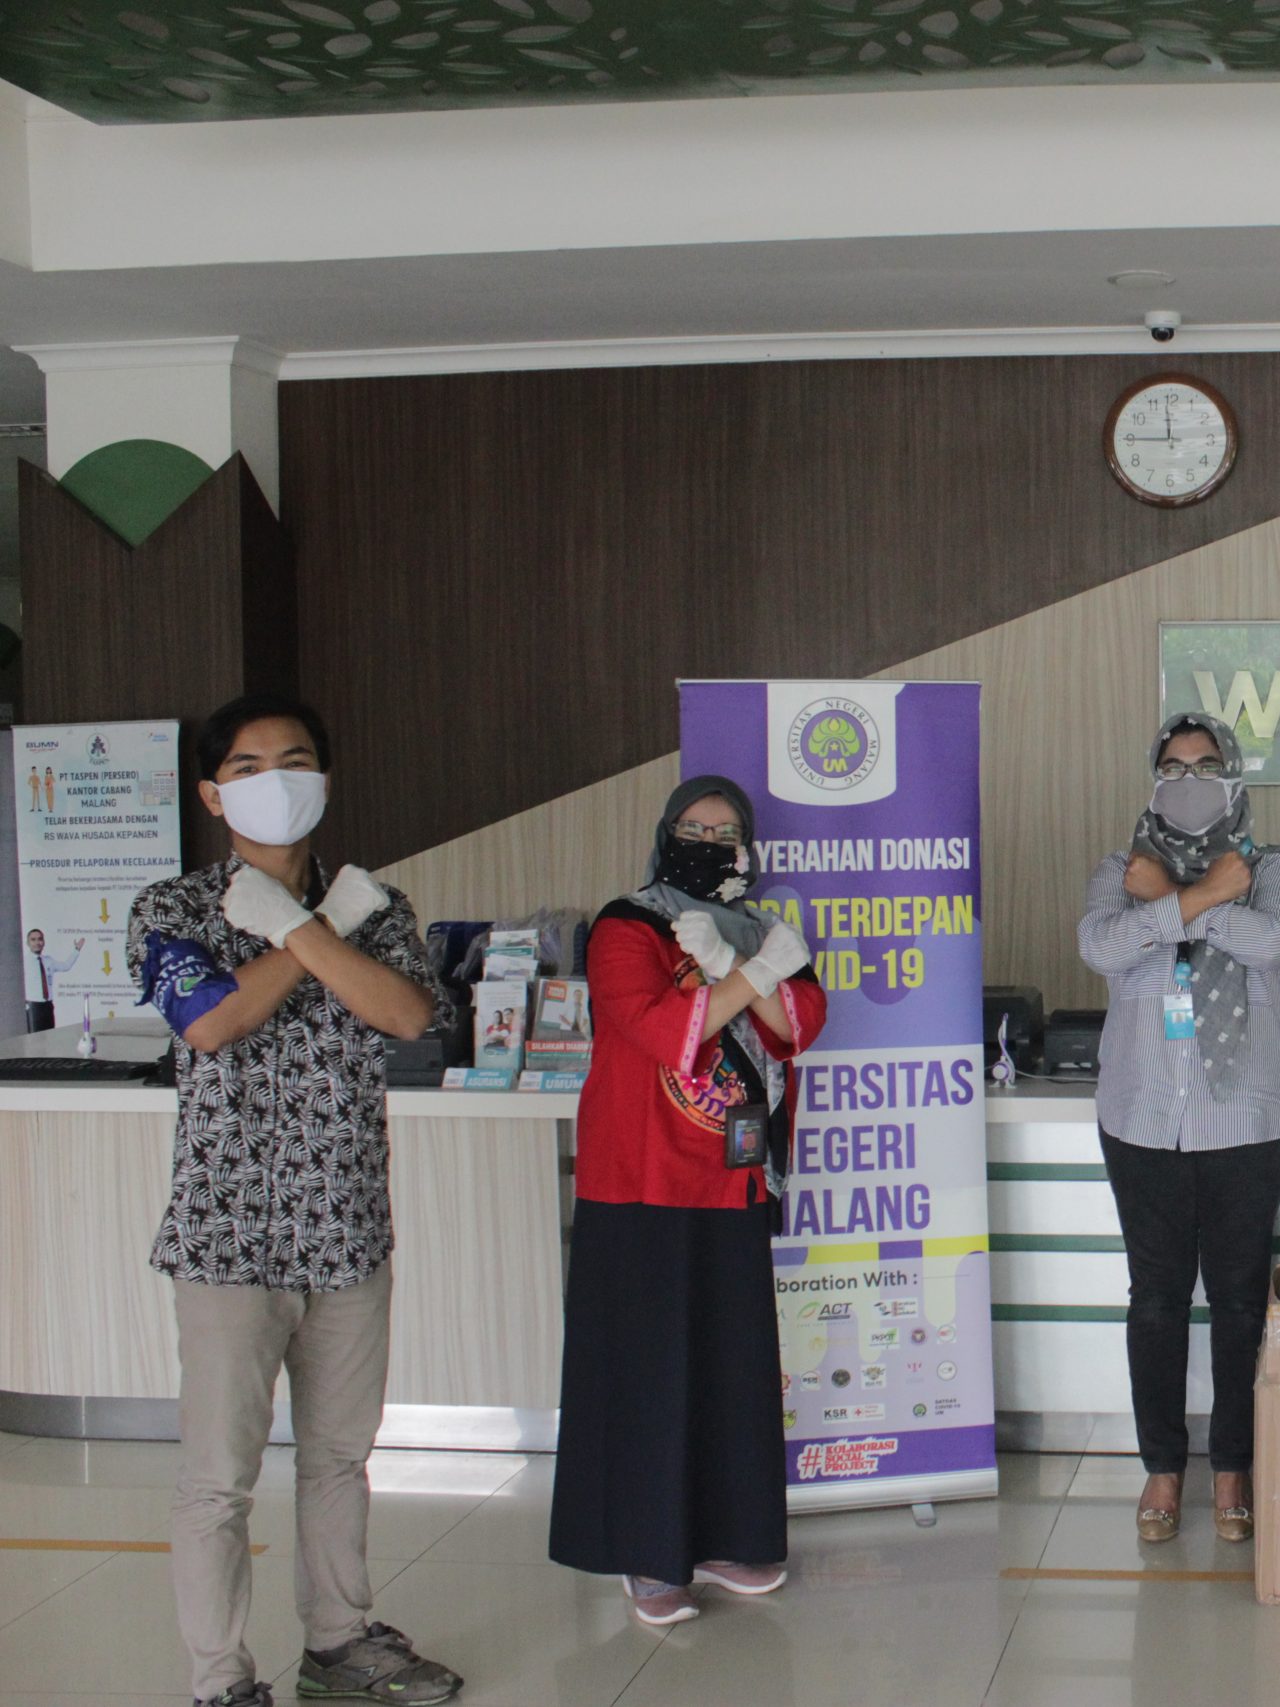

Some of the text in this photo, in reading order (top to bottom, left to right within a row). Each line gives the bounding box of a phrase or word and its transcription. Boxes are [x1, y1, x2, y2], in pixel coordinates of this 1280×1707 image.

[1148, 400, 1158, 411] 11
[1164, 394, 1179, 407] 12
[1189, 400, 1193, 411] 1
[1133, 412, 1145, 425] 10
[1201, 413, 1209, 425] 2
[1126, 433, 1135, 446] 9
[1206, 434, 1215, 446] 3
[1131, 454, 1140, 467] 8
[1199, 454, 1208, 467] 4
[1146, 469, 1155, 482] 7
[1166, 474, 1174, 487] 6
[1186, 469, 1194, 482] 5
[791, 701, 876, 785] UNIVERSITAS NEGERI MALANG
[823, 758, 848, 772] UM
[70, 772, 98, 780] TASPEN
[101, 771, 139, 779] (PERSERO)
[67, 786, 131, 795] KANTOR CABANG
[81, 799, 116, 807] MALANG
[45, 815, 158, 825] TELAH BEKERJASAMA DENGAN
[57, 832, 79, 840] WAVA
[117, 830, 158, 838] KEPANJEN
[754, 838, 969, 873] YERAHAN DONASI
[30, 857, 174, 867] PROSEDUR PELAPORAN KECELAKAAN
[811, 895, 973, 938] TERDEPAN
[789, 1122, 916, 1174] EGERI
[776, 1275, 857, 1293] boration
[863, 1271, 907, 1287] With
[820, 1303, 852, 1315] ACT
[824, 1409, 847, 1418] KSR
[825, 1441, 895, 1453] KOLABORASI
[825, 1453, 864, 1462] SOCIAL
[825, 1460, 875, 1472] PROJECT
